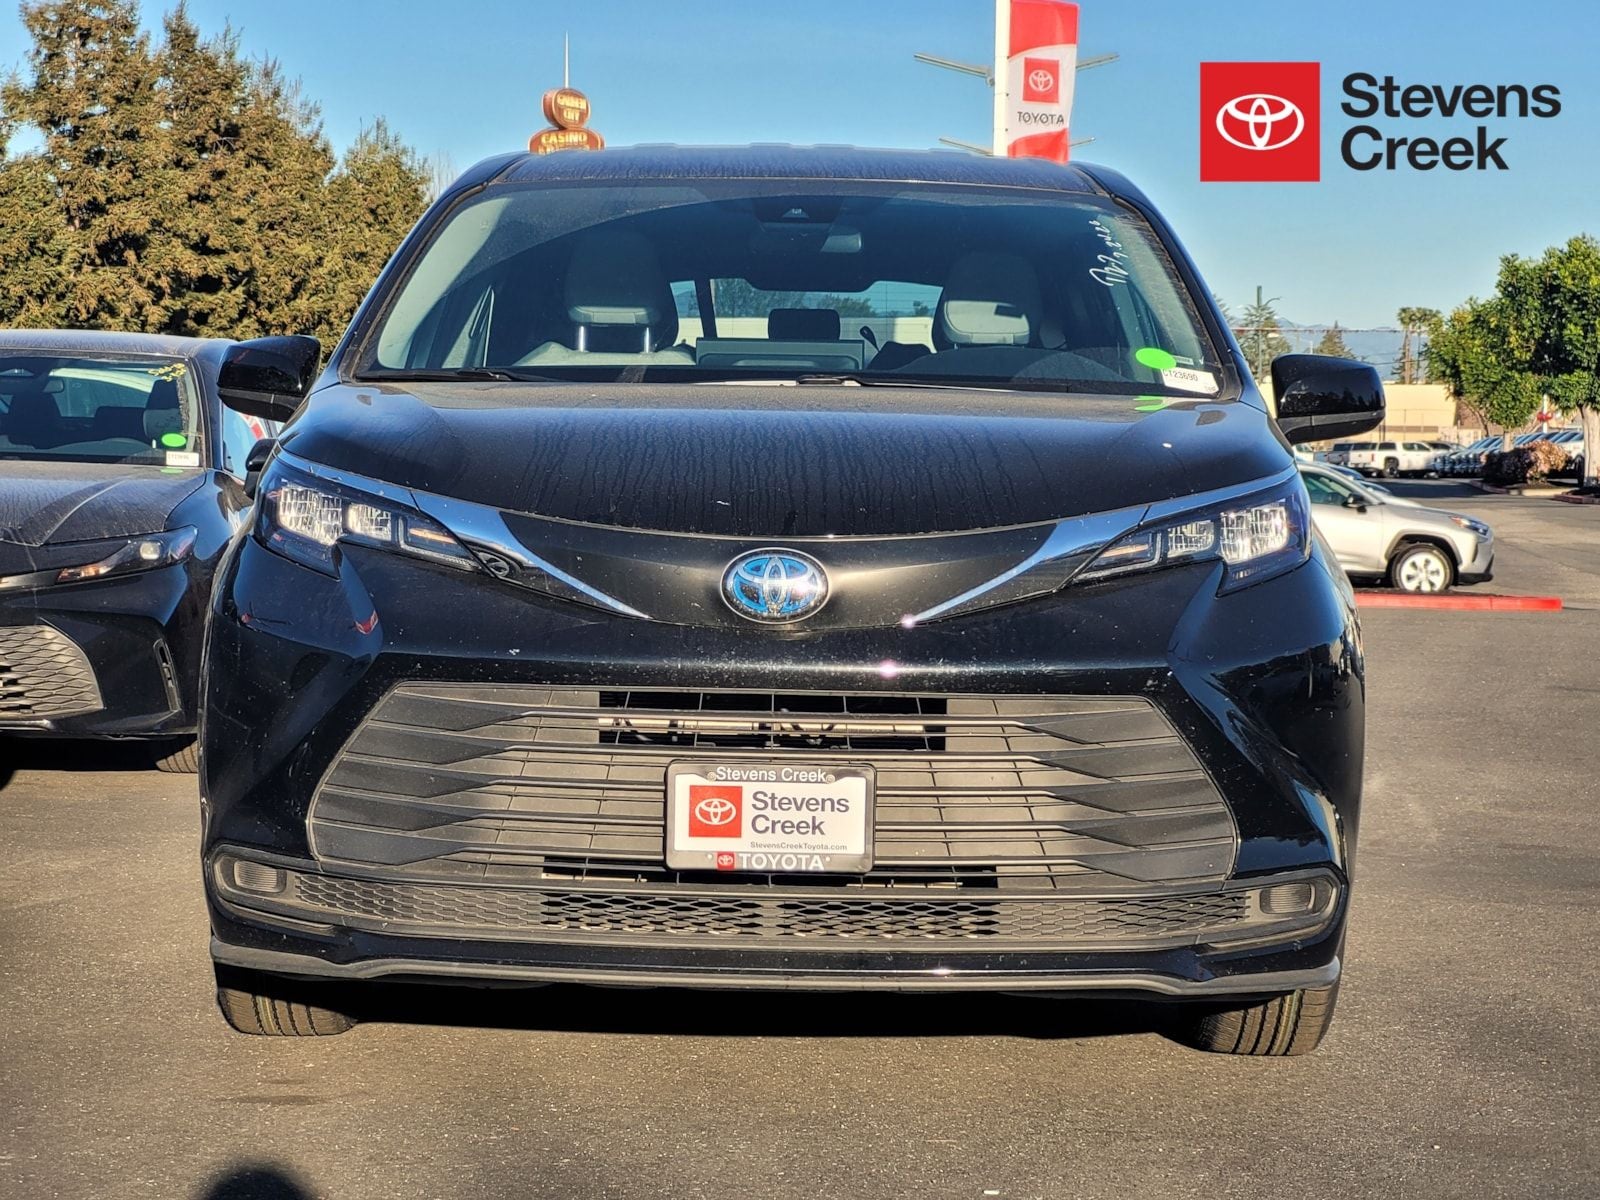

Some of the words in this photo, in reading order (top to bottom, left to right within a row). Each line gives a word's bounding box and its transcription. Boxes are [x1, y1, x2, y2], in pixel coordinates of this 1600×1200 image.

[1017, 111, 1065, 125] TOYOTA
[541, 132, 588, 145] CASINO
[716, 767, 776, 781] Stevens
[781, 768, 827, 783] Creek
[752, 791, 849, 812] Stevens
[751, 814, 825, 836] Creek
[750, 841, 848, 851] StevensCreekToyota.com
[739, 853, 825, 870] TOYOTA
